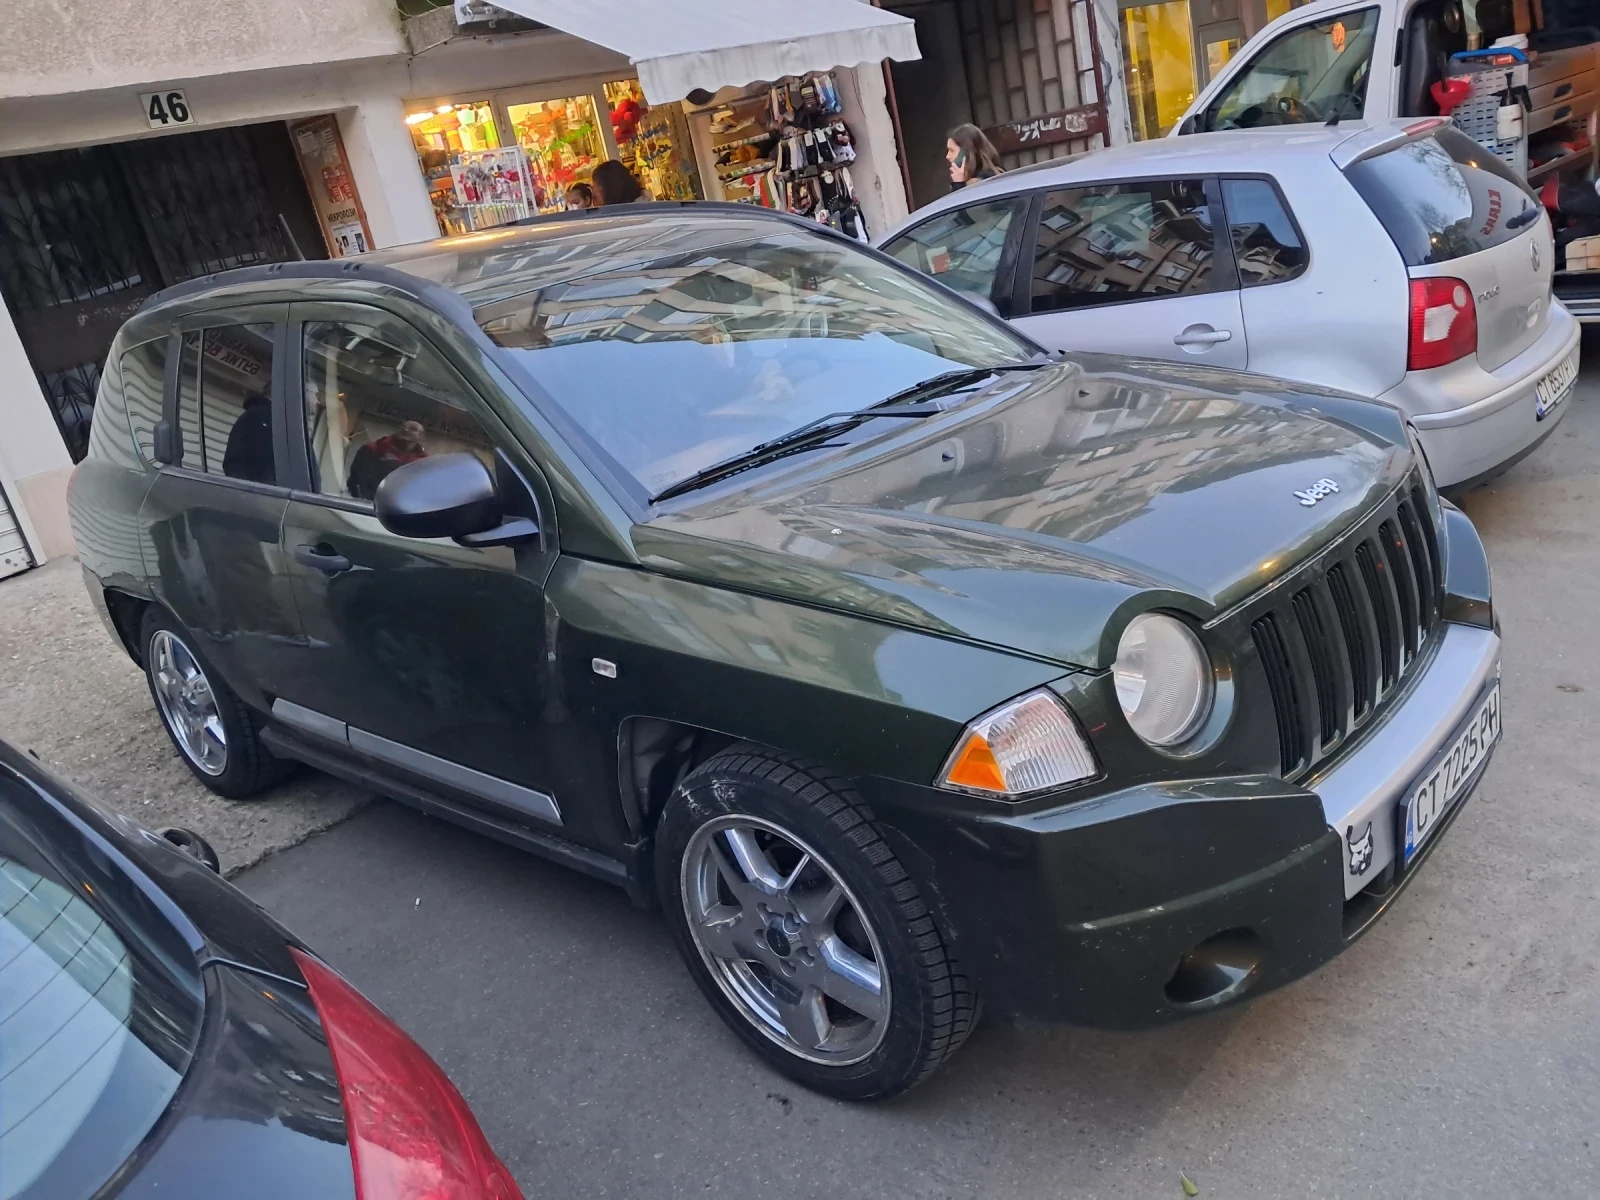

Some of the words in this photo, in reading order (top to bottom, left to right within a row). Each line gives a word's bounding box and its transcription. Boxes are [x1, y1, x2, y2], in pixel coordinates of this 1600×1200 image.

[149, 92, 189, 124] 46
[1537, 377, 1551, 405] CT
[1293, 478, 1340, 507] Jeep
[1416, 771, 1440, 833] CT
[1443, 721, 1478, 800] 7225
[1480, 692, 1498, 750] PH
